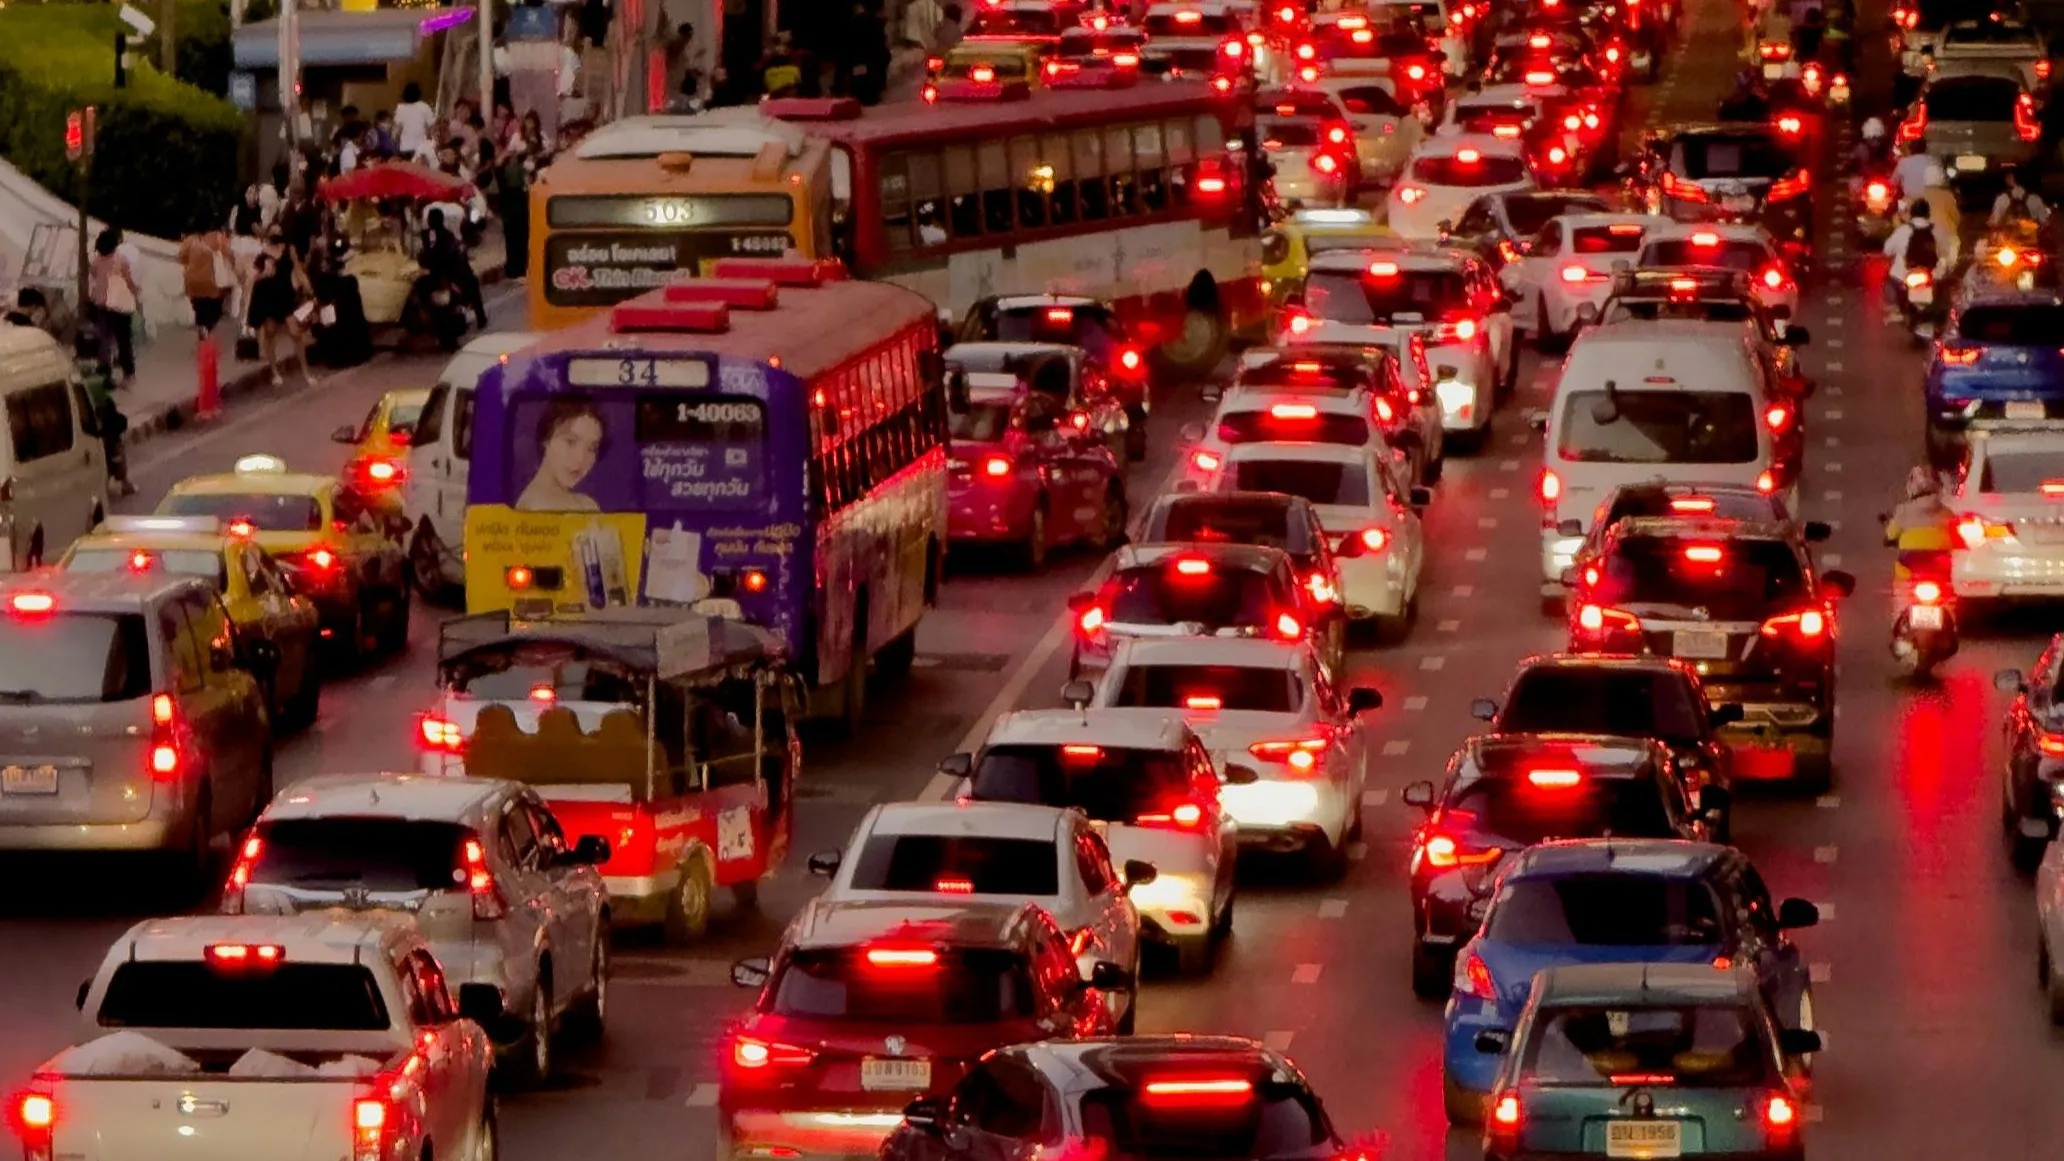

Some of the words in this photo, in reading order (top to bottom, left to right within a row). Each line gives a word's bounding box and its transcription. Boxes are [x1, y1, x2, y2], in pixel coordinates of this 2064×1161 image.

[644, 200, 694, 221] 503
[617, 360, 658, 385] 34
[677, 403, 761, 422] 1-40063
